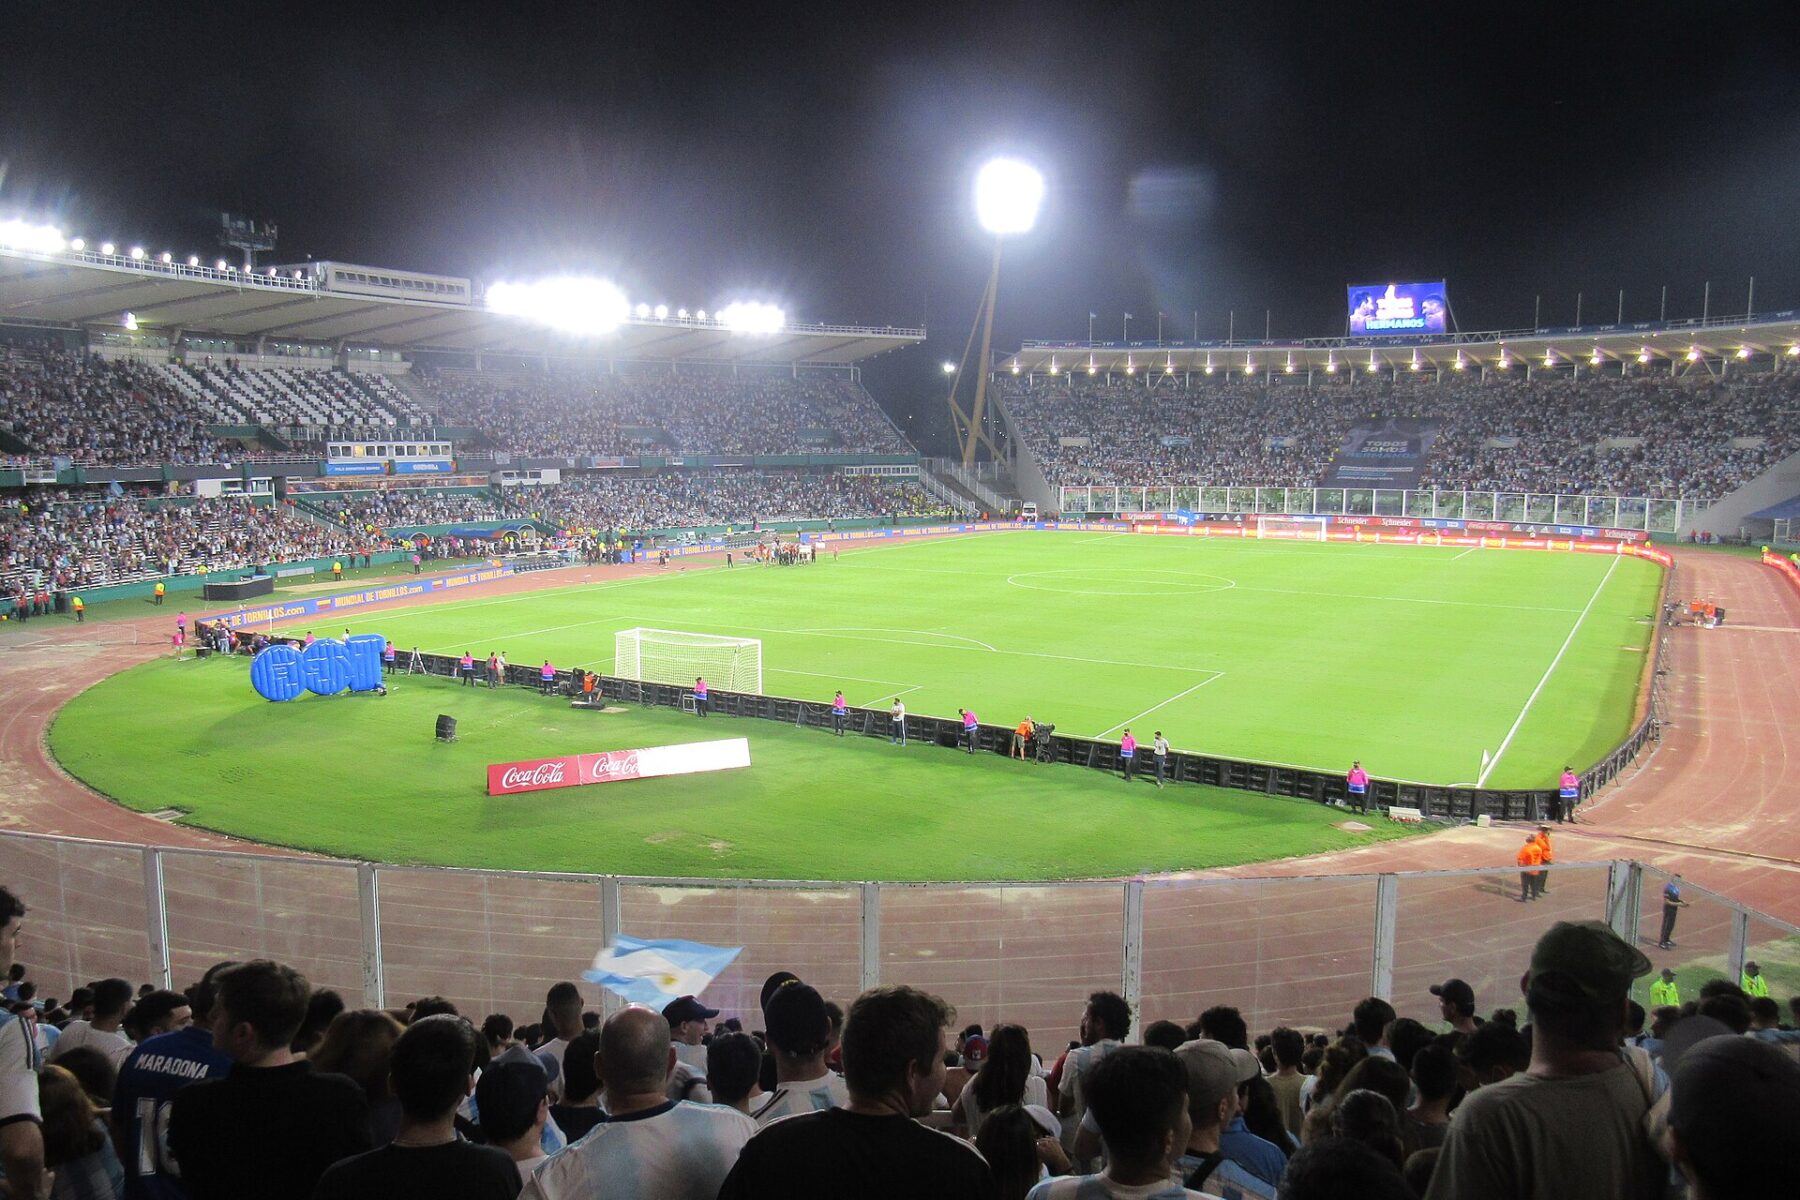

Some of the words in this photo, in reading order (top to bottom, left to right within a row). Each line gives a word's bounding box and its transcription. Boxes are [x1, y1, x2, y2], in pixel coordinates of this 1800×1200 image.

[1366, 318, 1424, 329] HERMANOS
[1127, 513, 1156, 521] Schneider
[1337, 517, 1368, 525] Schneider
[1381, 518, 1413, 527] Schneider
[1604, 529, 1638, 540] Schneider
[682, 545, 725, 555] TORNILLOS.com
[446, 576, 469, 588] MUNDIAL
[470, 573, 478, 584] DE
[478, 568, 514, 581] TORNILLOS.com
[335, 592, 364, 607] MUNDIAL
[366, 592, 374, 603] DE
[375, 584, 423, 601] TORNILLOS.com
[231, 615, 242, 627] DE
[243, 605, 305, 624] TORNILLOS.com
[592, 754, 639, 778] Coca-Co
[502, 762, 566, 788] Coca-Cola
[134, 1053, 210, 1079] MARADONA
